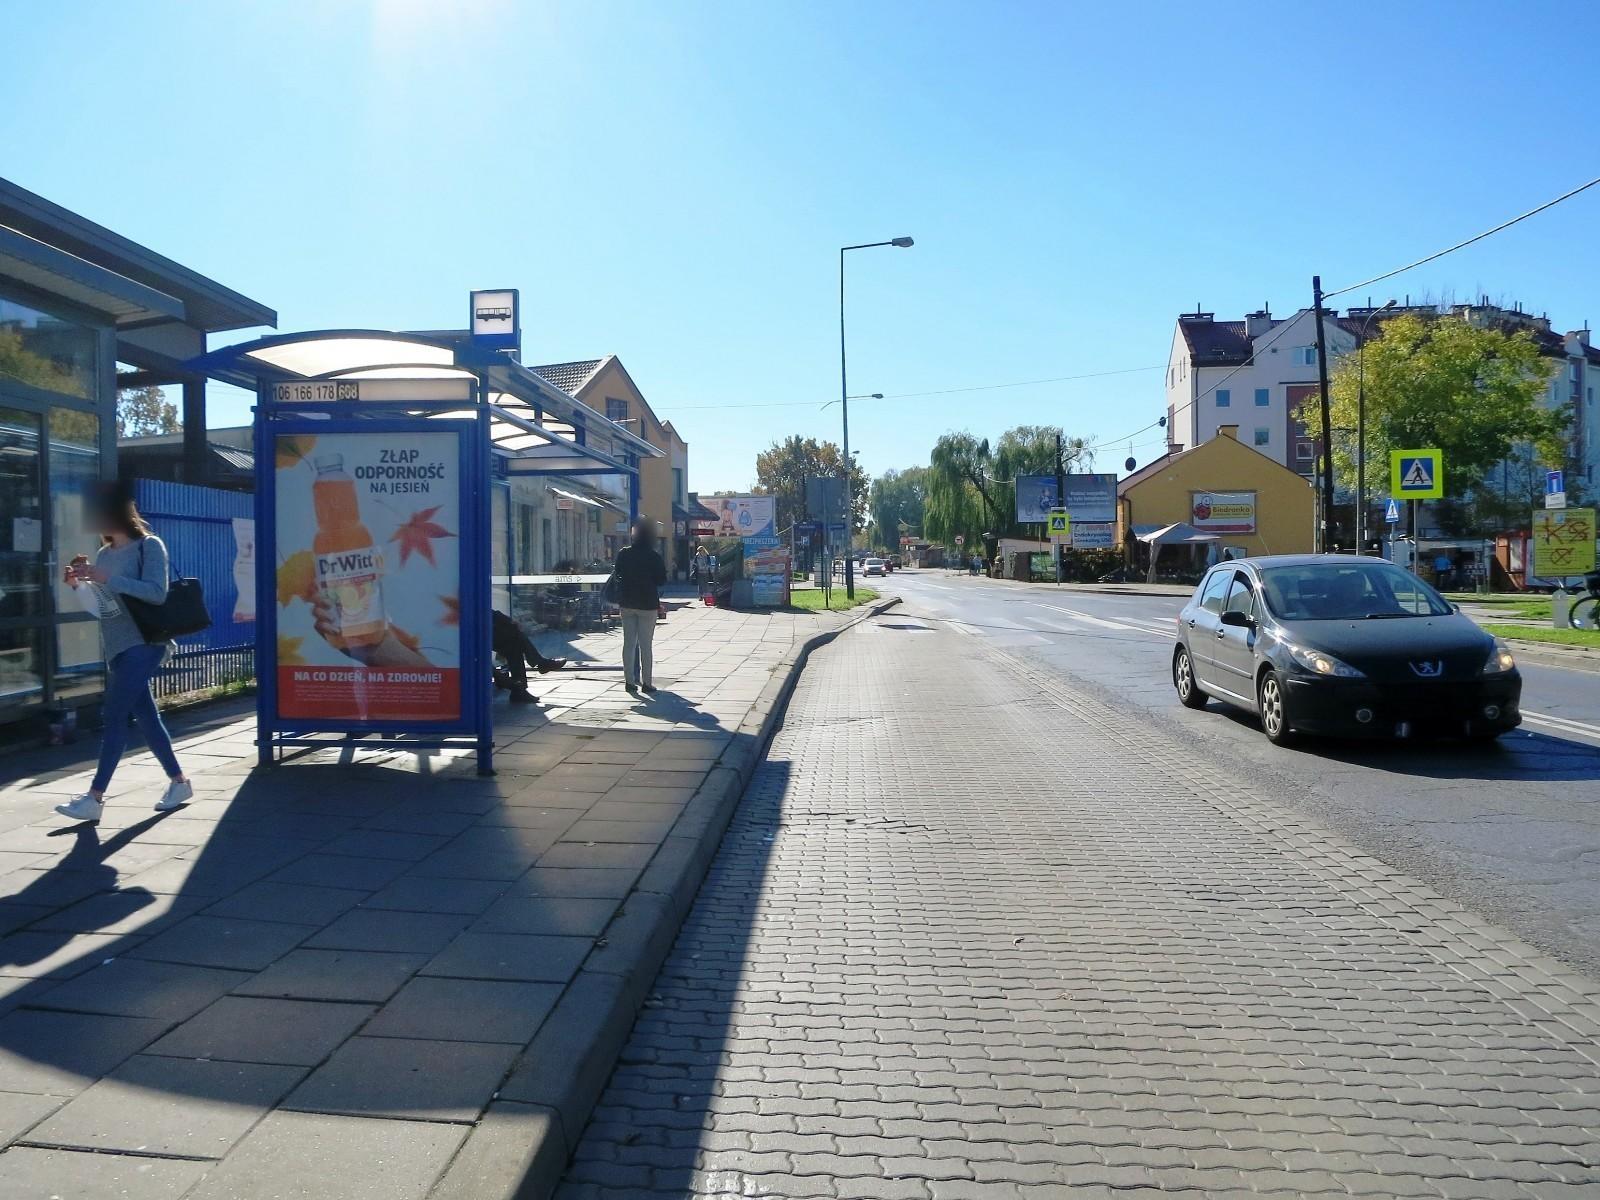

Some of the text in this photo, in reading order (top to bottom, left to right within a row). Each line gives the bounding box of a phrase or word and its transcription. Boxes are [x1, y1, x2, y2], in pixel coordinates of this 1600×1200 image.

[273, 385, 291, 400] 106
[294, 385, 313, 400] 166
[316, 385, 335, 400] 178
[379, 449, 420, 464] ZŁAP
[354, 462, 446, 480] ODPORNOŚĆ
[369, 479, 430, 496] NA JESIEŃ
[294, 669, 442, 684] NA CO DZIEŃ, NA ZDROWIE!
